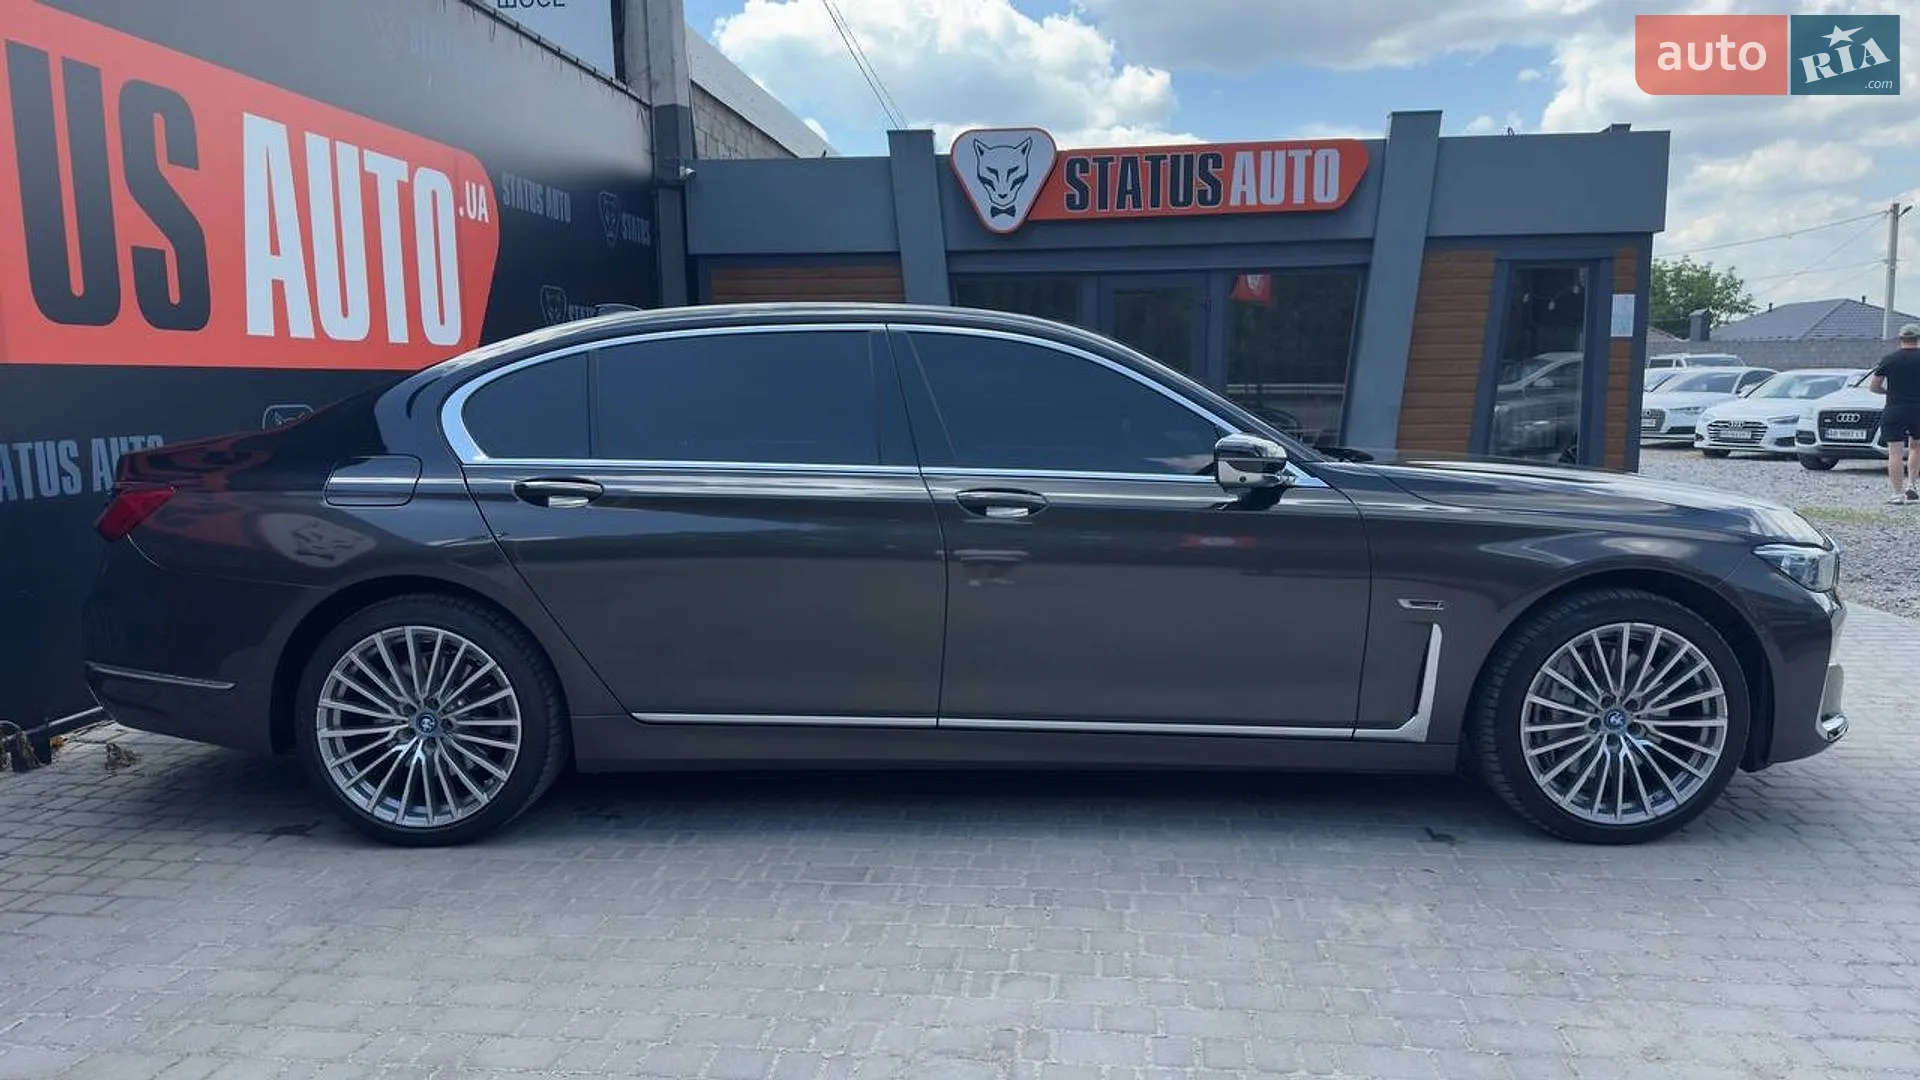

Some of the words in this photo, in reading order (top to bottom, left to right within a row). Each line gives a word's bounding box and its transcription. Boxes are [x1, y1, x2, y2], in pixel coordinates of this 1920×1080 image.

[502, 172, 544, 216] STATUS
[545, 185, 571, 224] AUTO
[1064, 152, 1223, 212] STATUS
[1230, 148, 1342, 206] AUTO
[621, 212, 651, 246] STATUS
